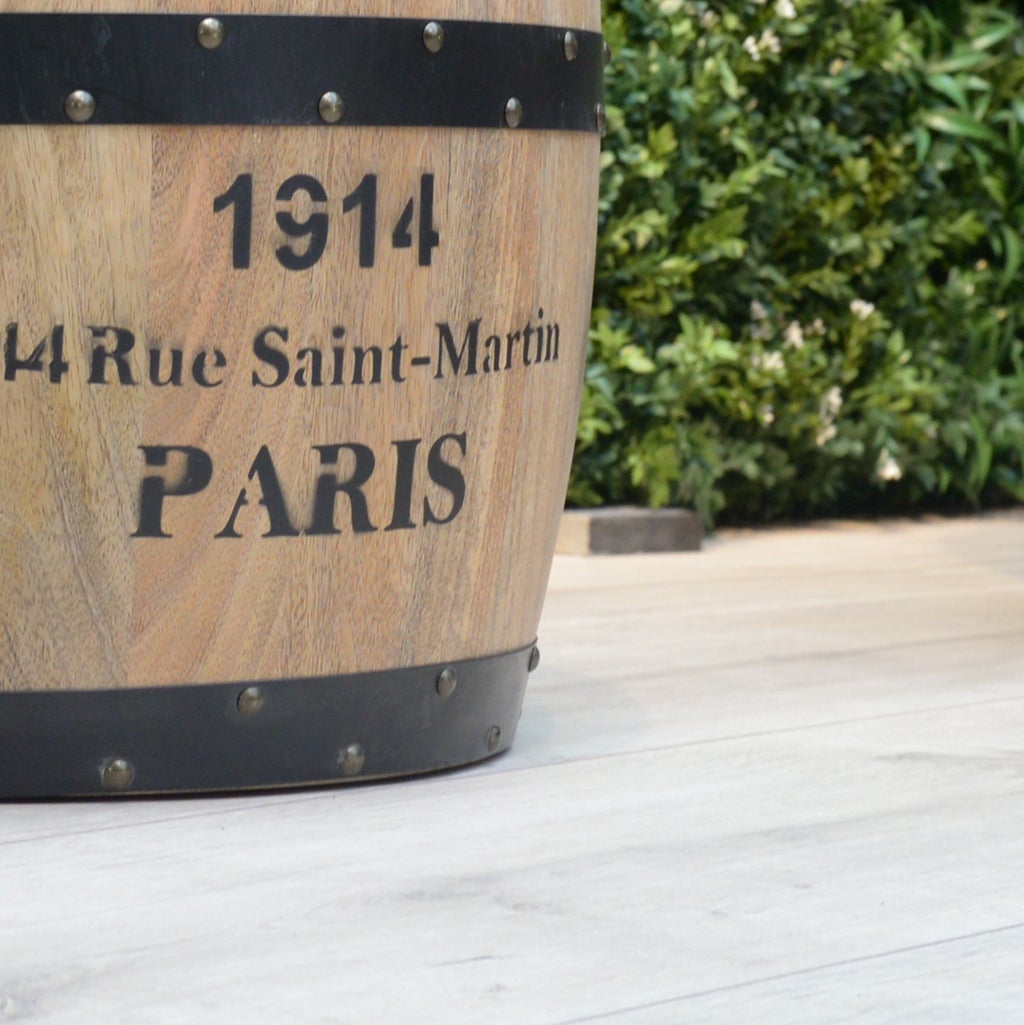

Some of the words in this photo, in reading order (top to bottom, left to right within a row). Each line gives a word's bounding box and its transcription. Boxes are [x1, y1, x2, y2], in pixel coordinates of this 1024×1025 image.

[213, 173, 439, 271] 1914
[85, 325, 227, 389] Rue
[252, 307, 560, 389] Saint-Martin
[130, 431, 467, 538] PARIS
